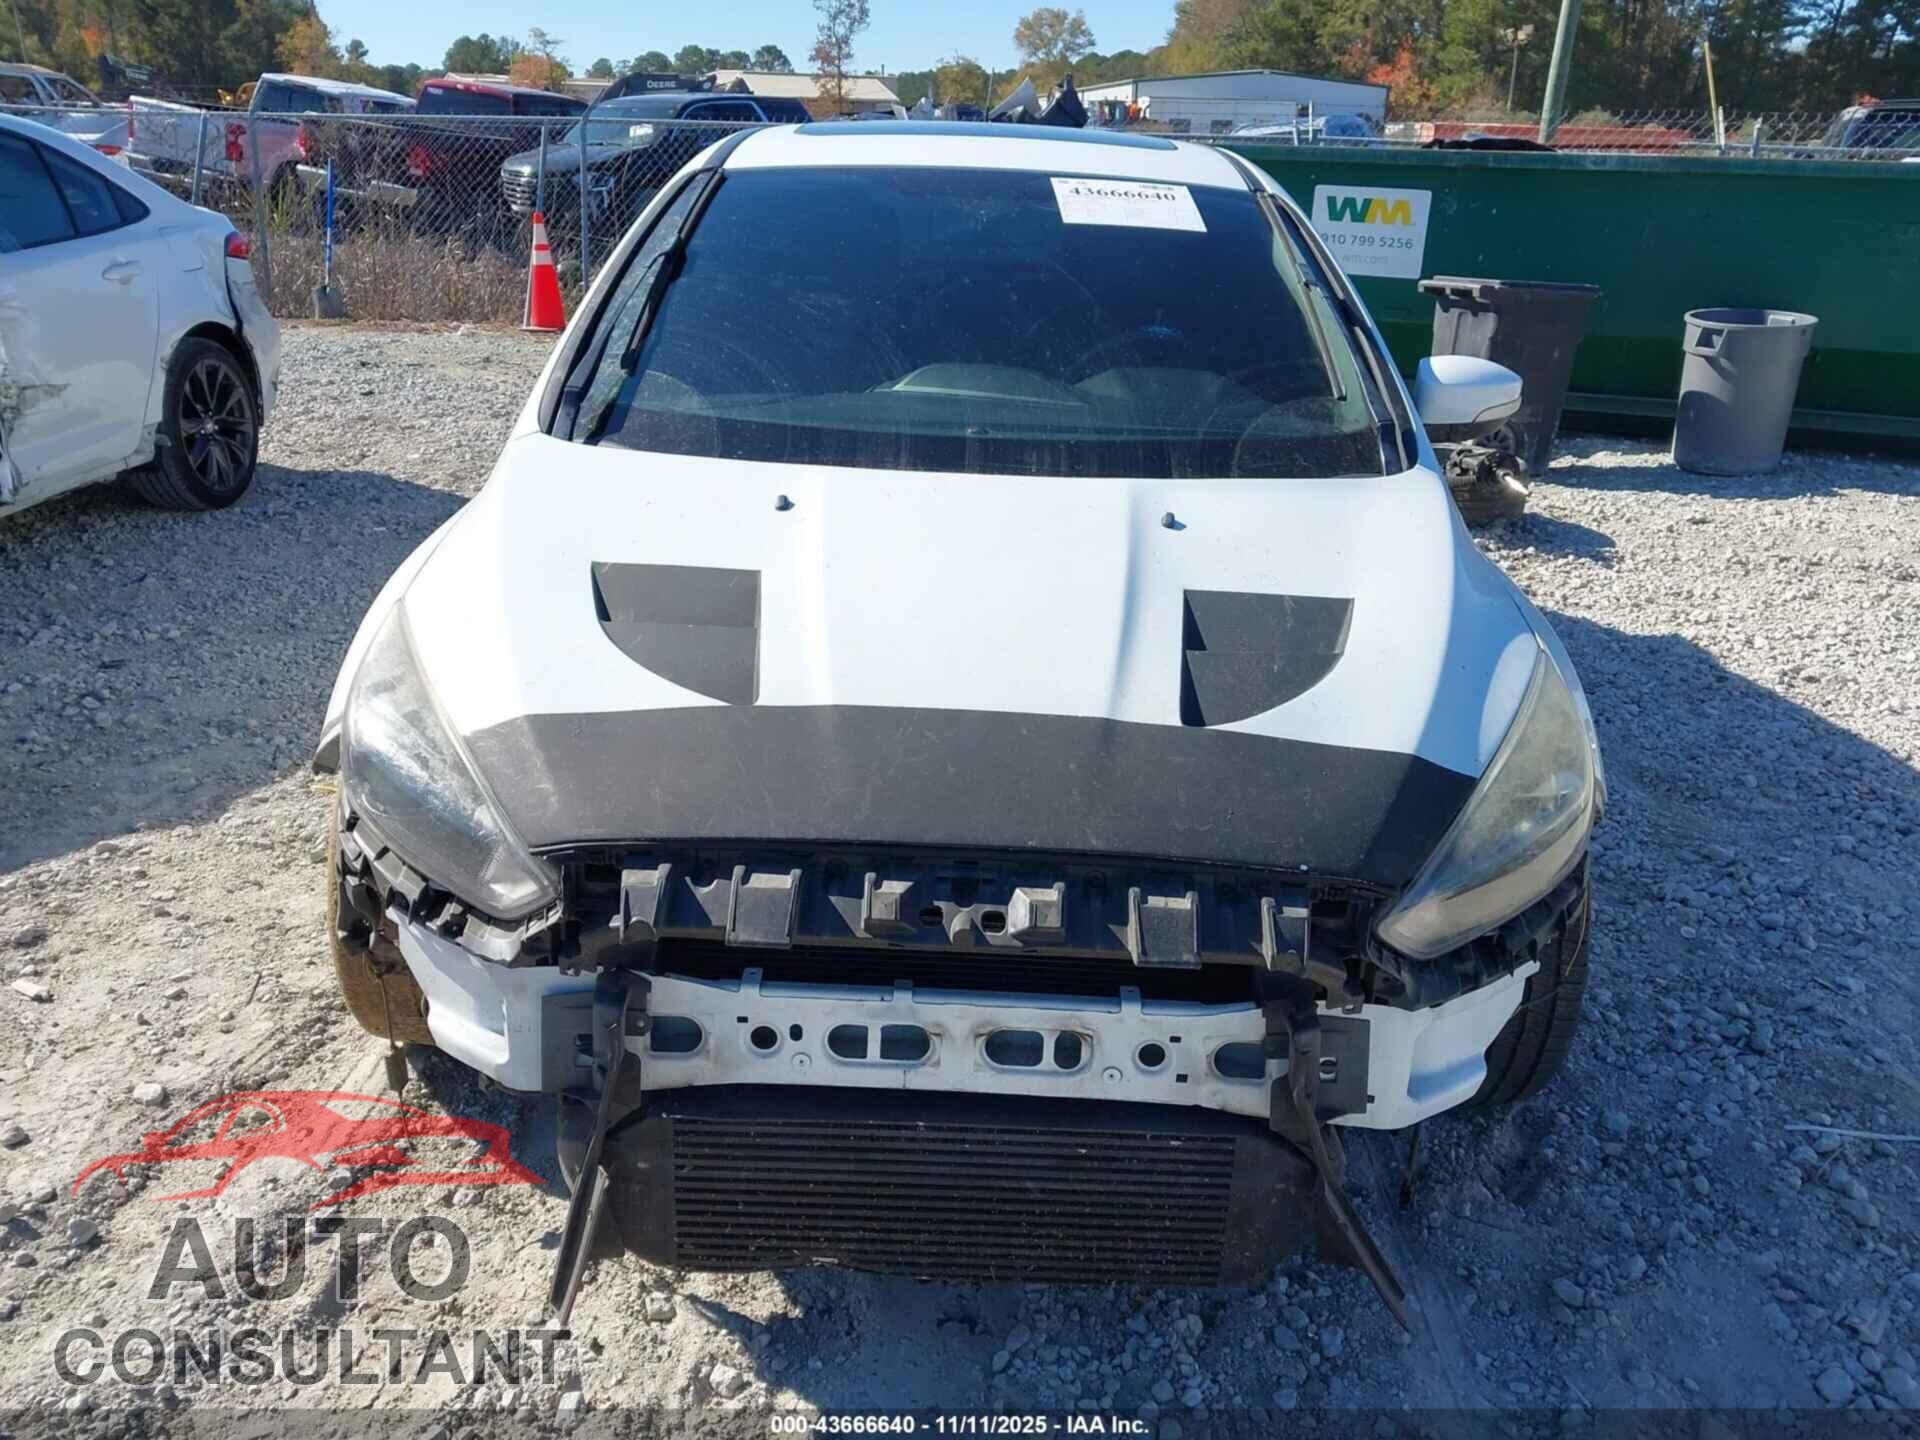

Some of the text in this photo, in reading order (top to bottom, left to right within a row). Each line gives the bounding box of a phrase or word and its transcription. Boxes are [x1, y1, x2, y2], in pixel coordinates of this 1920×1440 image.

[646, 80, 677, 89] DEERE
[1326, 195, 1413, 226] WM
[1320, 232, 1414, 250] 910 799 5256
